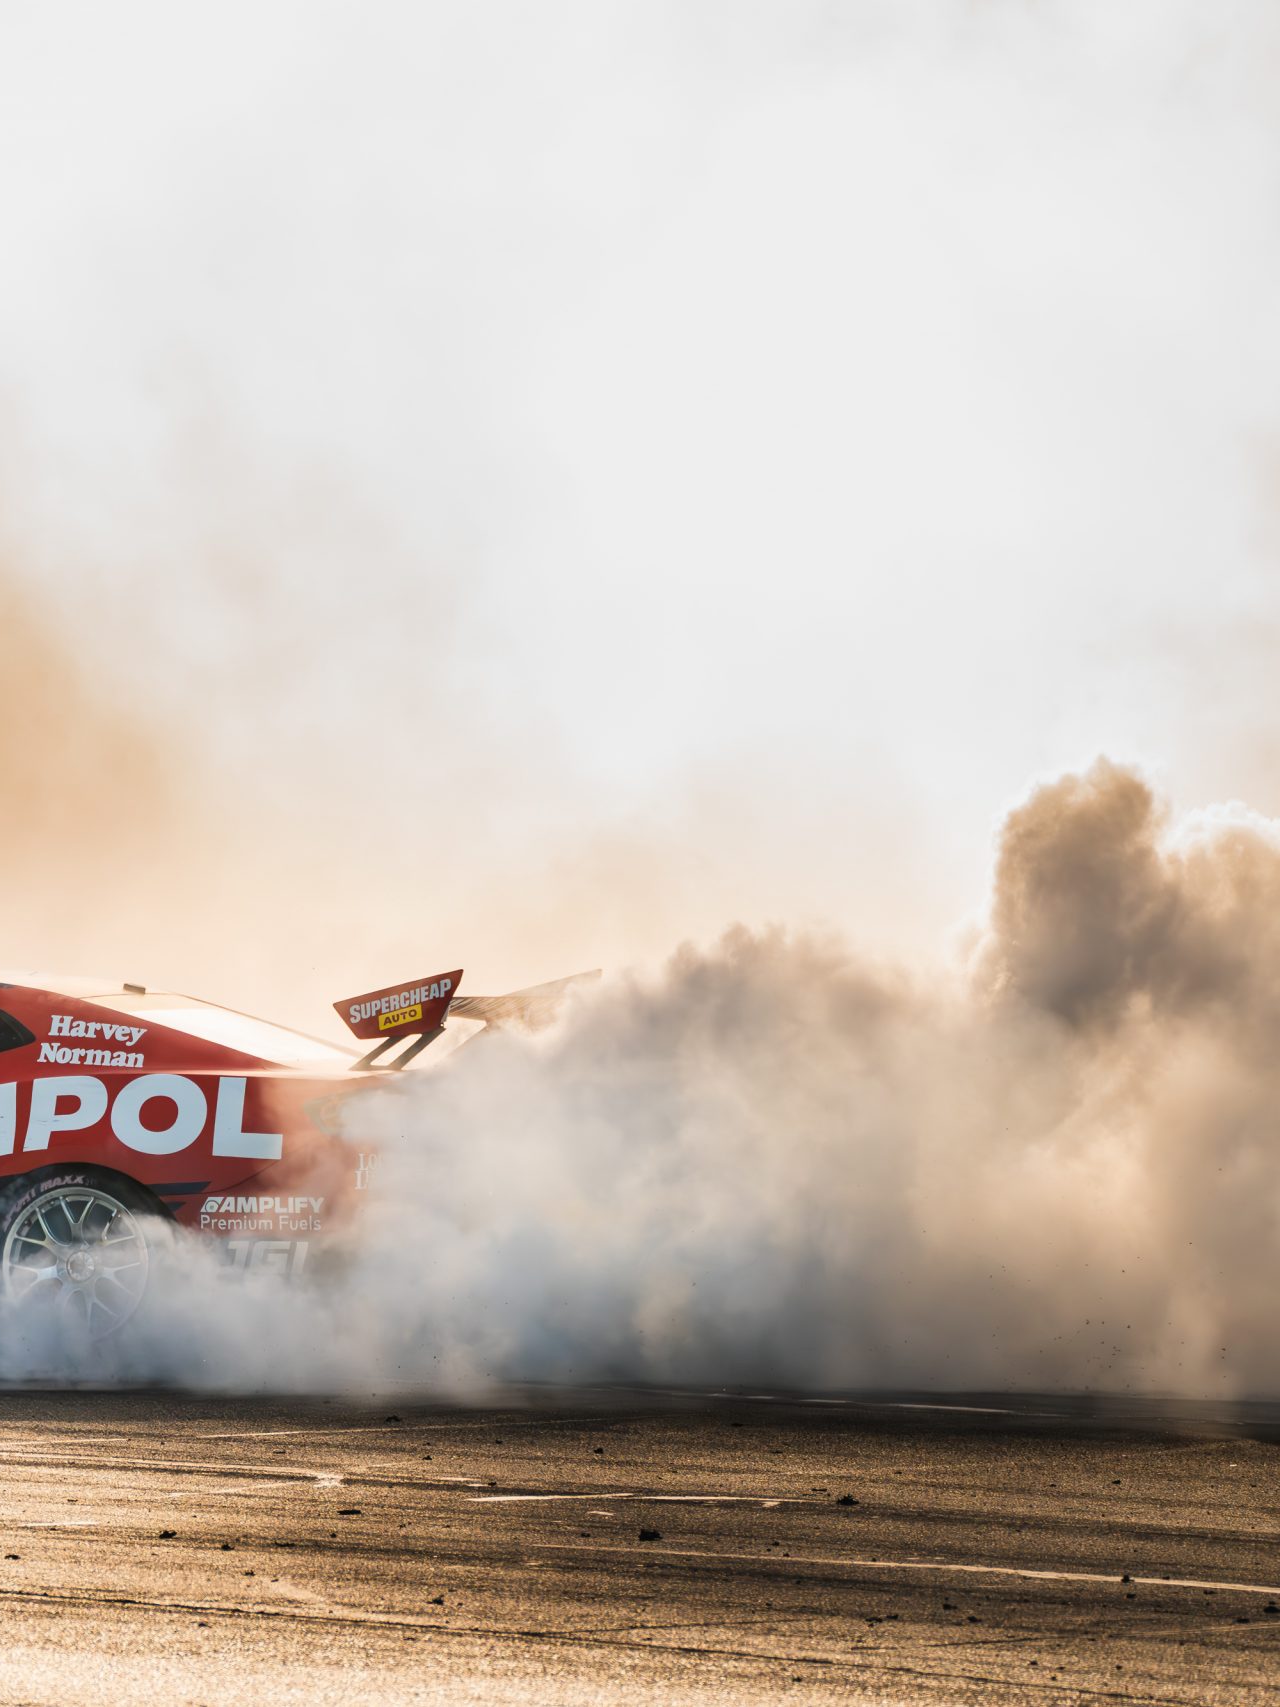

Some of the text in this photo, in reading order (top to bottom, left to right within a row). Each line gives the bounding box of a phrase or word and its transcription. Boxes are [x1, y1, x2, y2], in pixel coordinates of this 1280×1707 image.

[349, 979, 452, 1023] SUPERCHEAP
[383, 1009, 418, 1025] AUTO
[48, 1014, 148, 1046] Harvey
[37, 1043, 144, 1068] Norman
[219, 1196, 325, 1213] AMPLIFY
[200, 1215, 321, 1231] Premium Fuels
